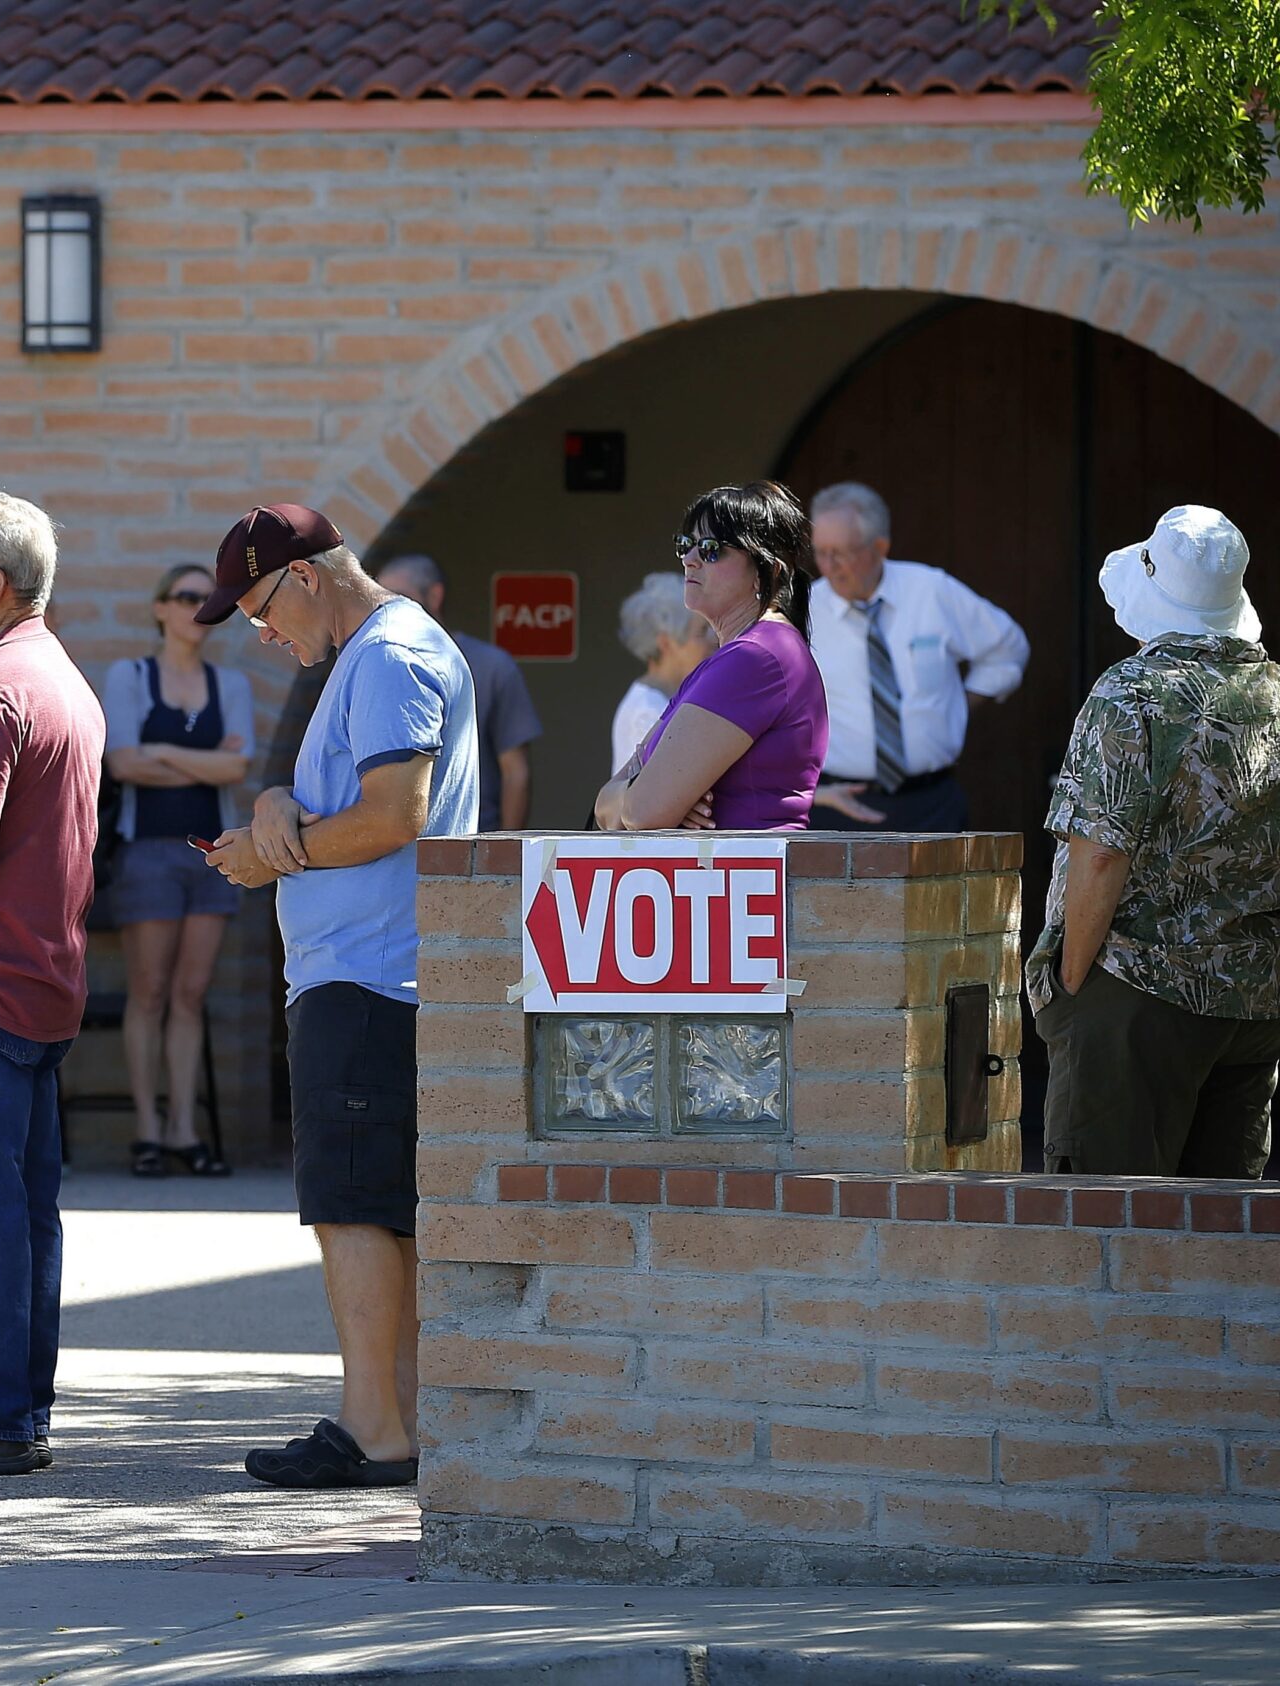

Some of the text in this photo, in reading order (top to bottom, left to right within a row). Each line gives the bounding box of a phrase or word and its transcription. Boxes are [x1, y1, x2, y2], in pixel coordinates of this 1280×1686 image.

[246, 546, 259, 577] DEVILS
[495, 603, 573, 629] FACP
[552, 868, 778, 985] VOTE
